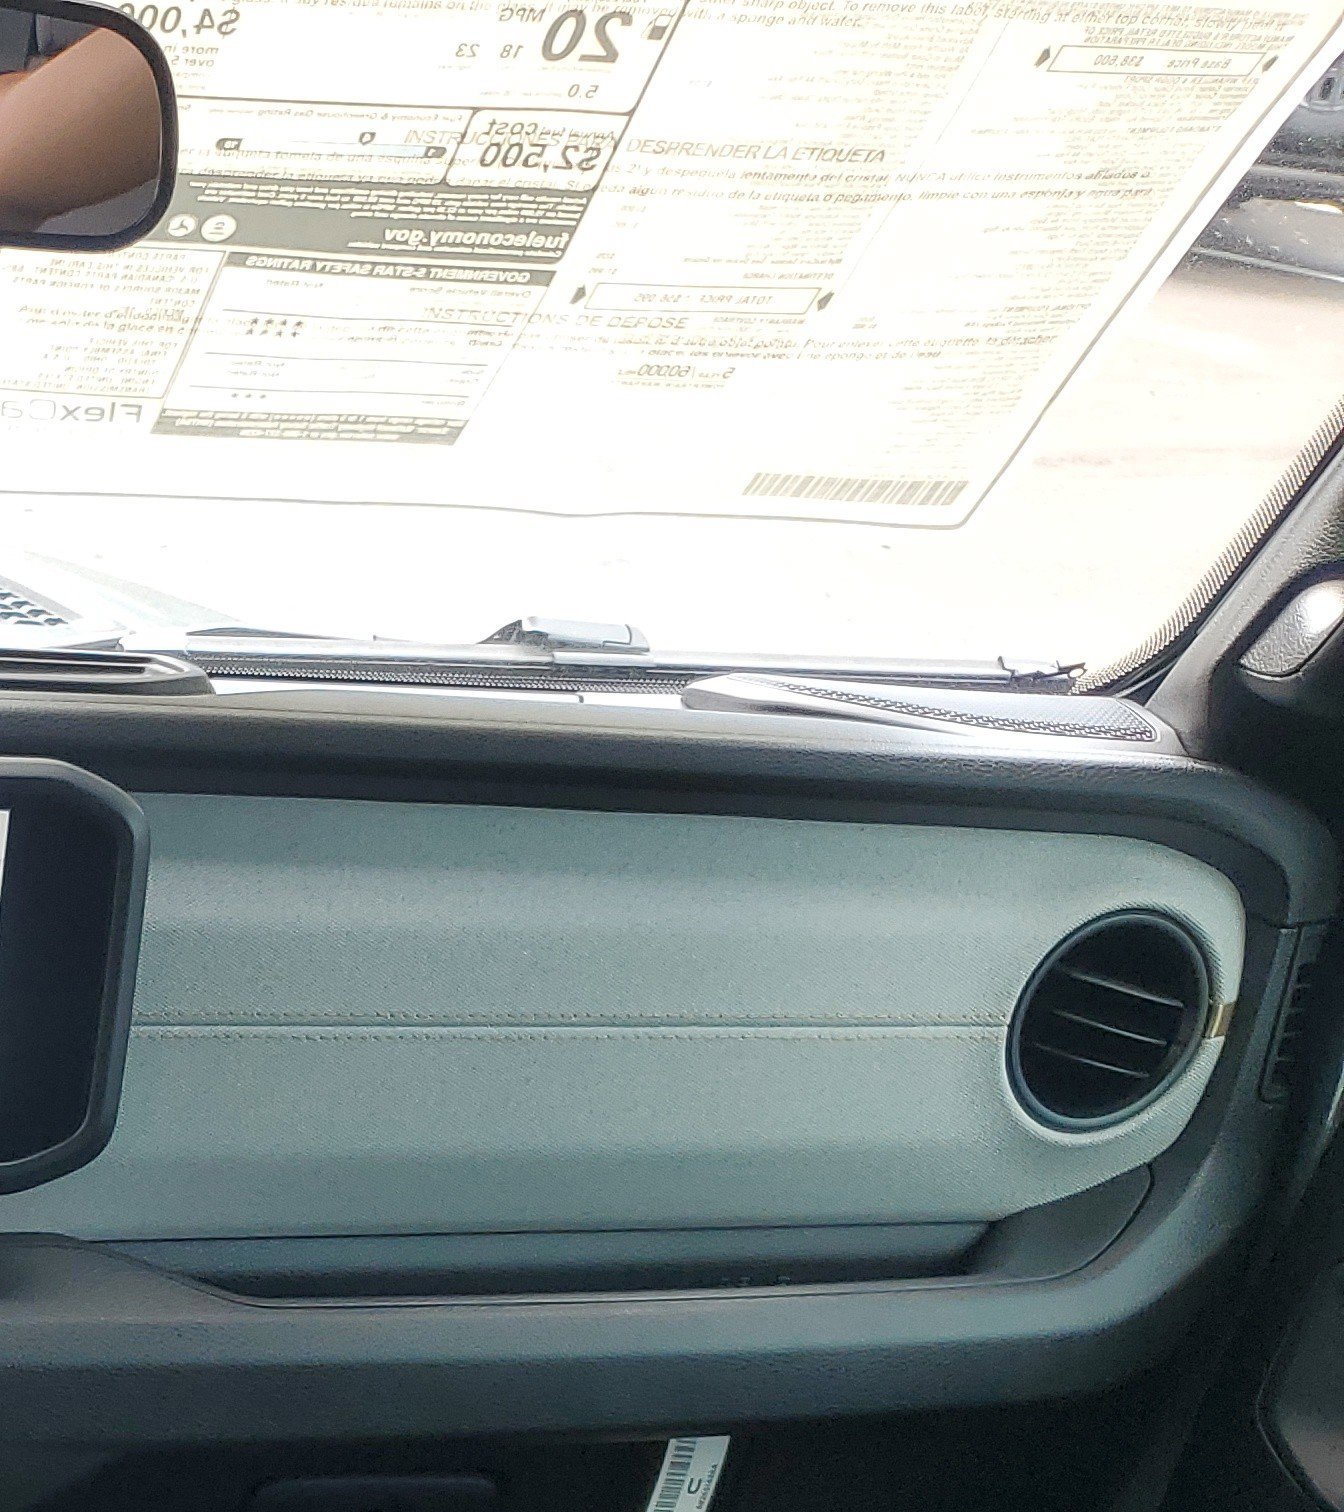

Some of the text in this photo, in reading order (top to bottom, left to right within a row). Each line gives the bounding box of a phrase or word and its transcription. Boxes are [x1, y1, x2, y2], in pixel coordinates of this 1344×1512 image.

[729, 14, 816, 28] sponge and
[994, 5, 1138, 28] starting either top
[625, 137, 760, 160] DESPRENDER
[762, 143, 790, 161] LA
[792, 145, 886, 164] ETIQUETA
[993, 171, 1082, 184] instrumentos
